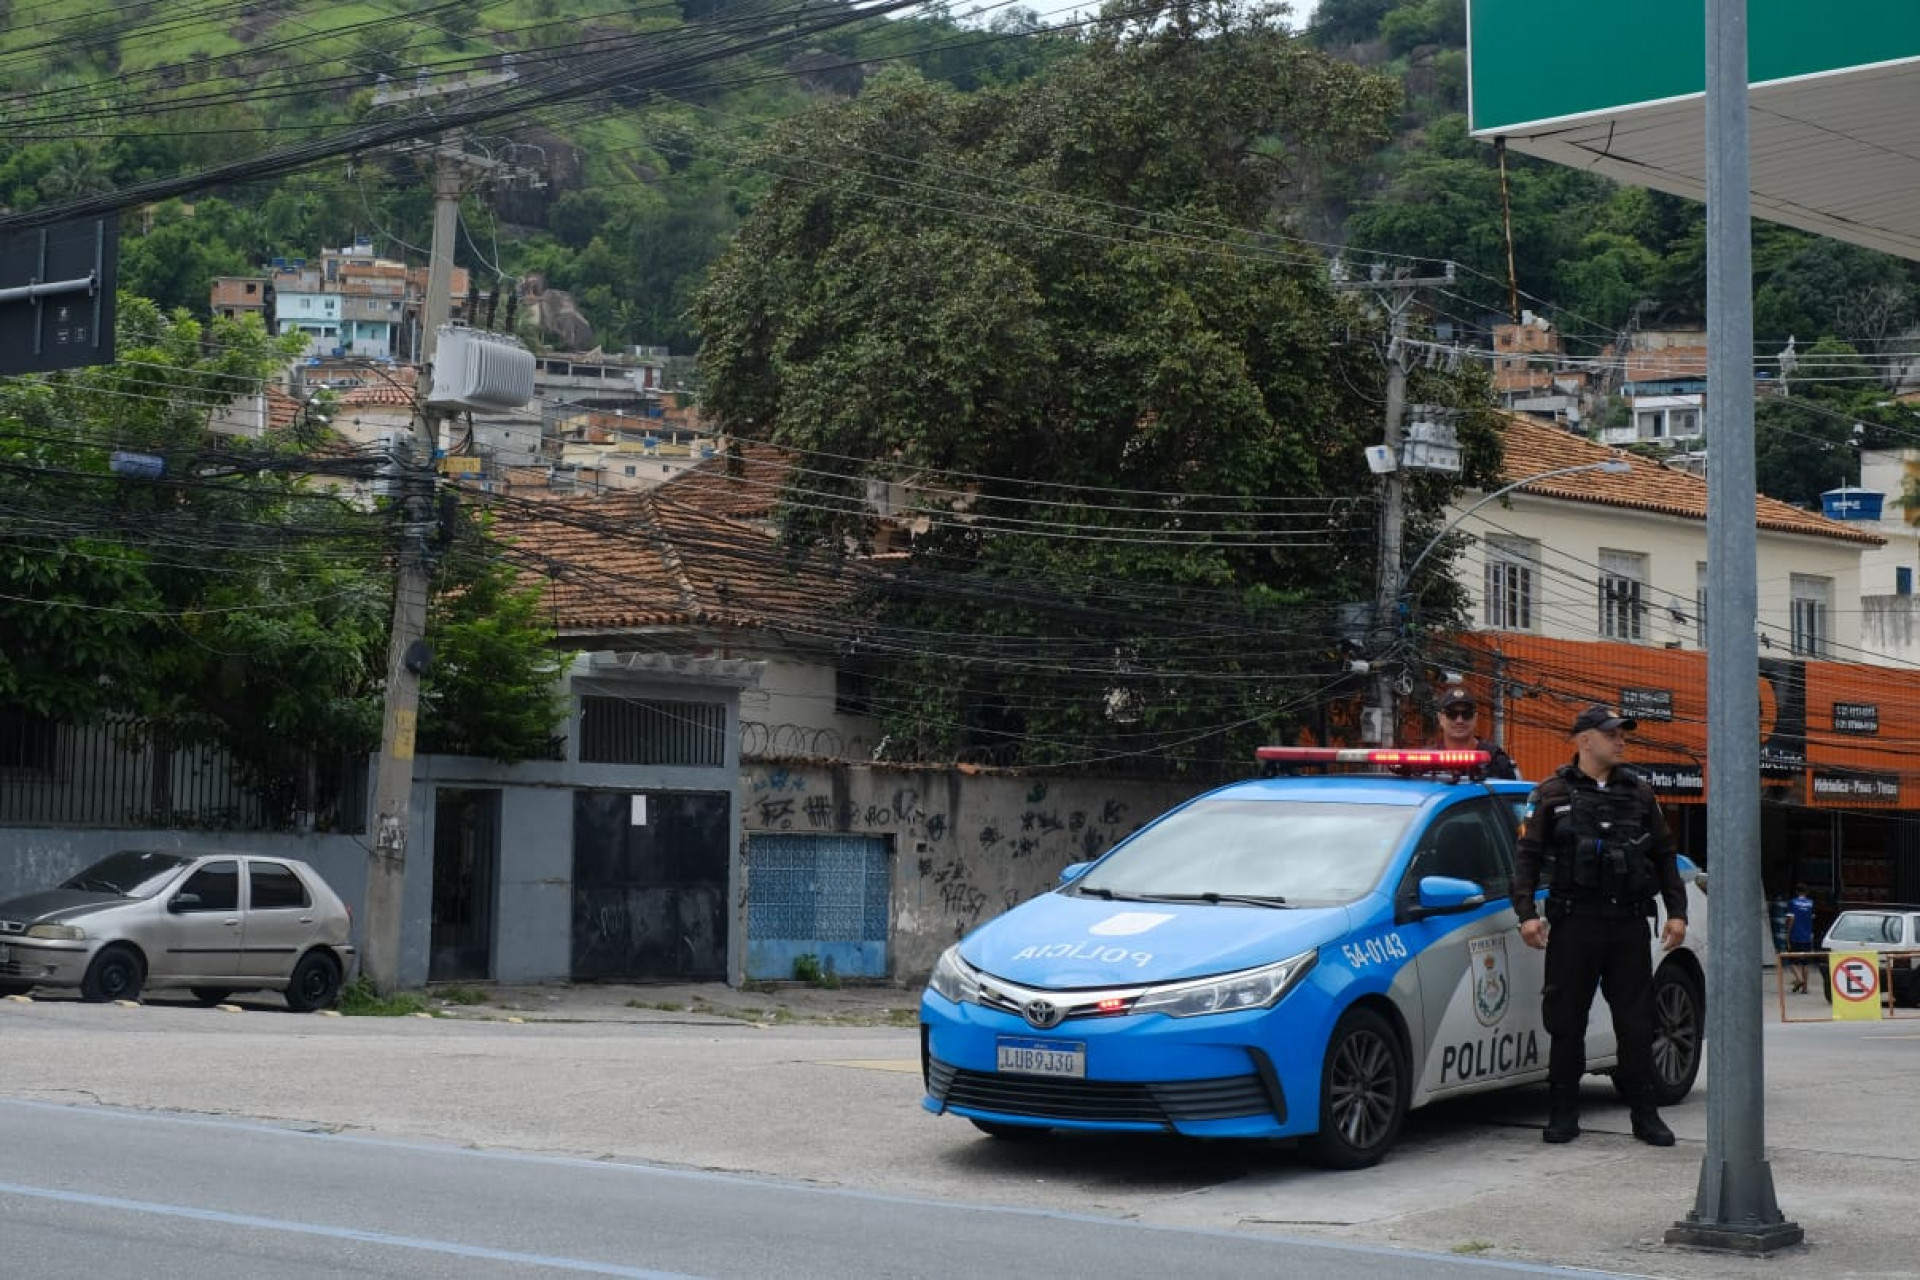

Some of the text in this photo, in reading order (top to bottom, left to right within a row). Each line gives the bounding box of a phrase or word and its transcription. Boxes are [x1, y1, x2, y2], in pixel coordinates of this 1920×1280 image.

[1341, 932, 1407, 968] 54-0143
[1845, 964, 1865, 994] E
[1440, 1027, 1538, 1083] POLÍCIA
